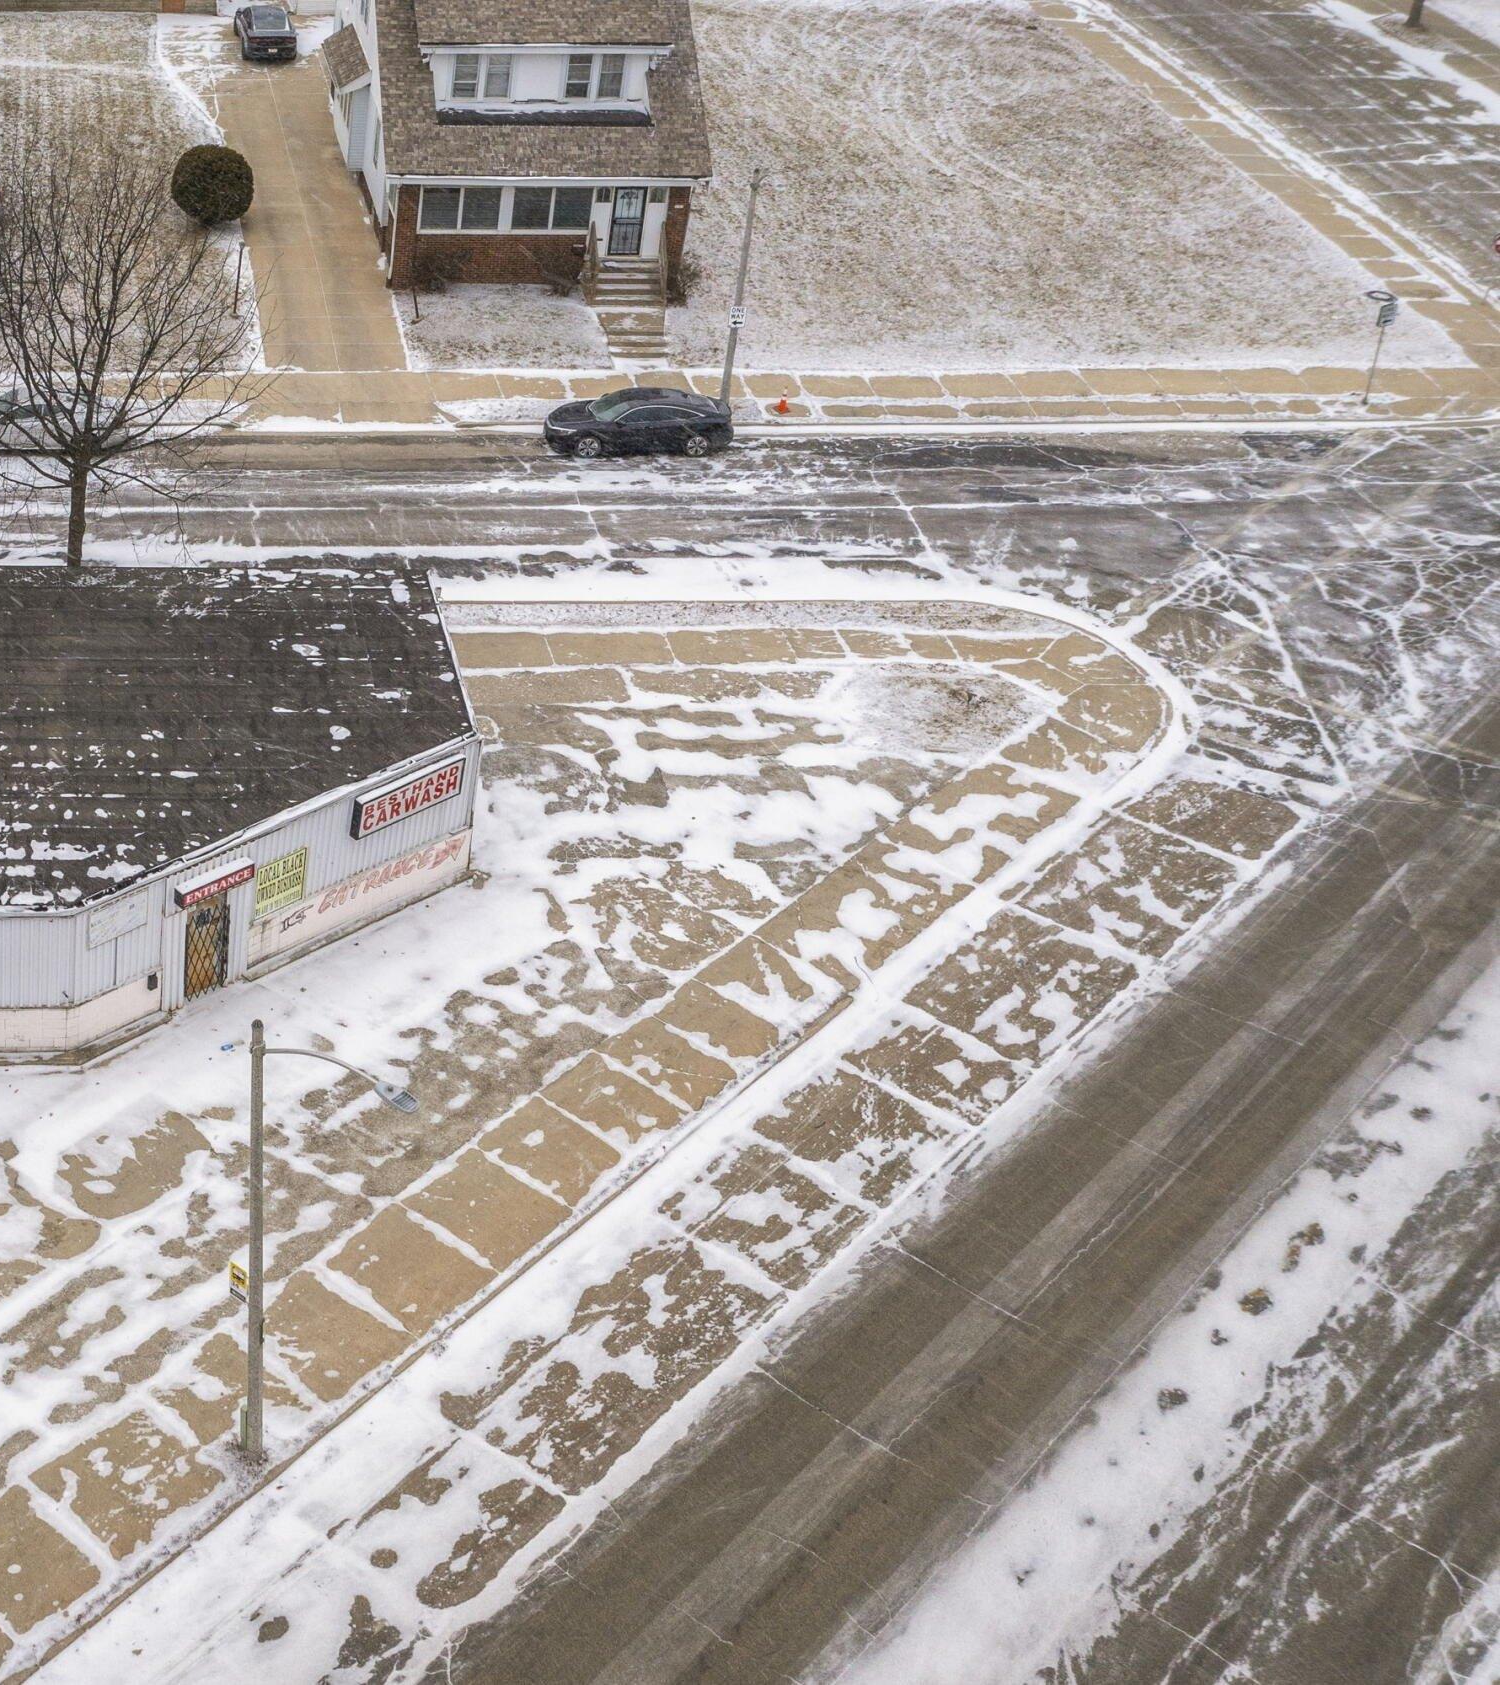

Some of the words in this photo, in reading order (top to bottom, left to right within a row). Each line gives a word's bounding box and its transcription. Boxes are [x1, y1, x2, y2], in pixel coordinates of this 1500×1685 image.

[185, 868, 252, 904] ENTRANCE
[259, 863, 280, 887] LOCAL
[282, 852, 304, 876] BLACK
[256, 883, 276, 905] OWNED
[276, 870, 302, 896] BUSINESS
